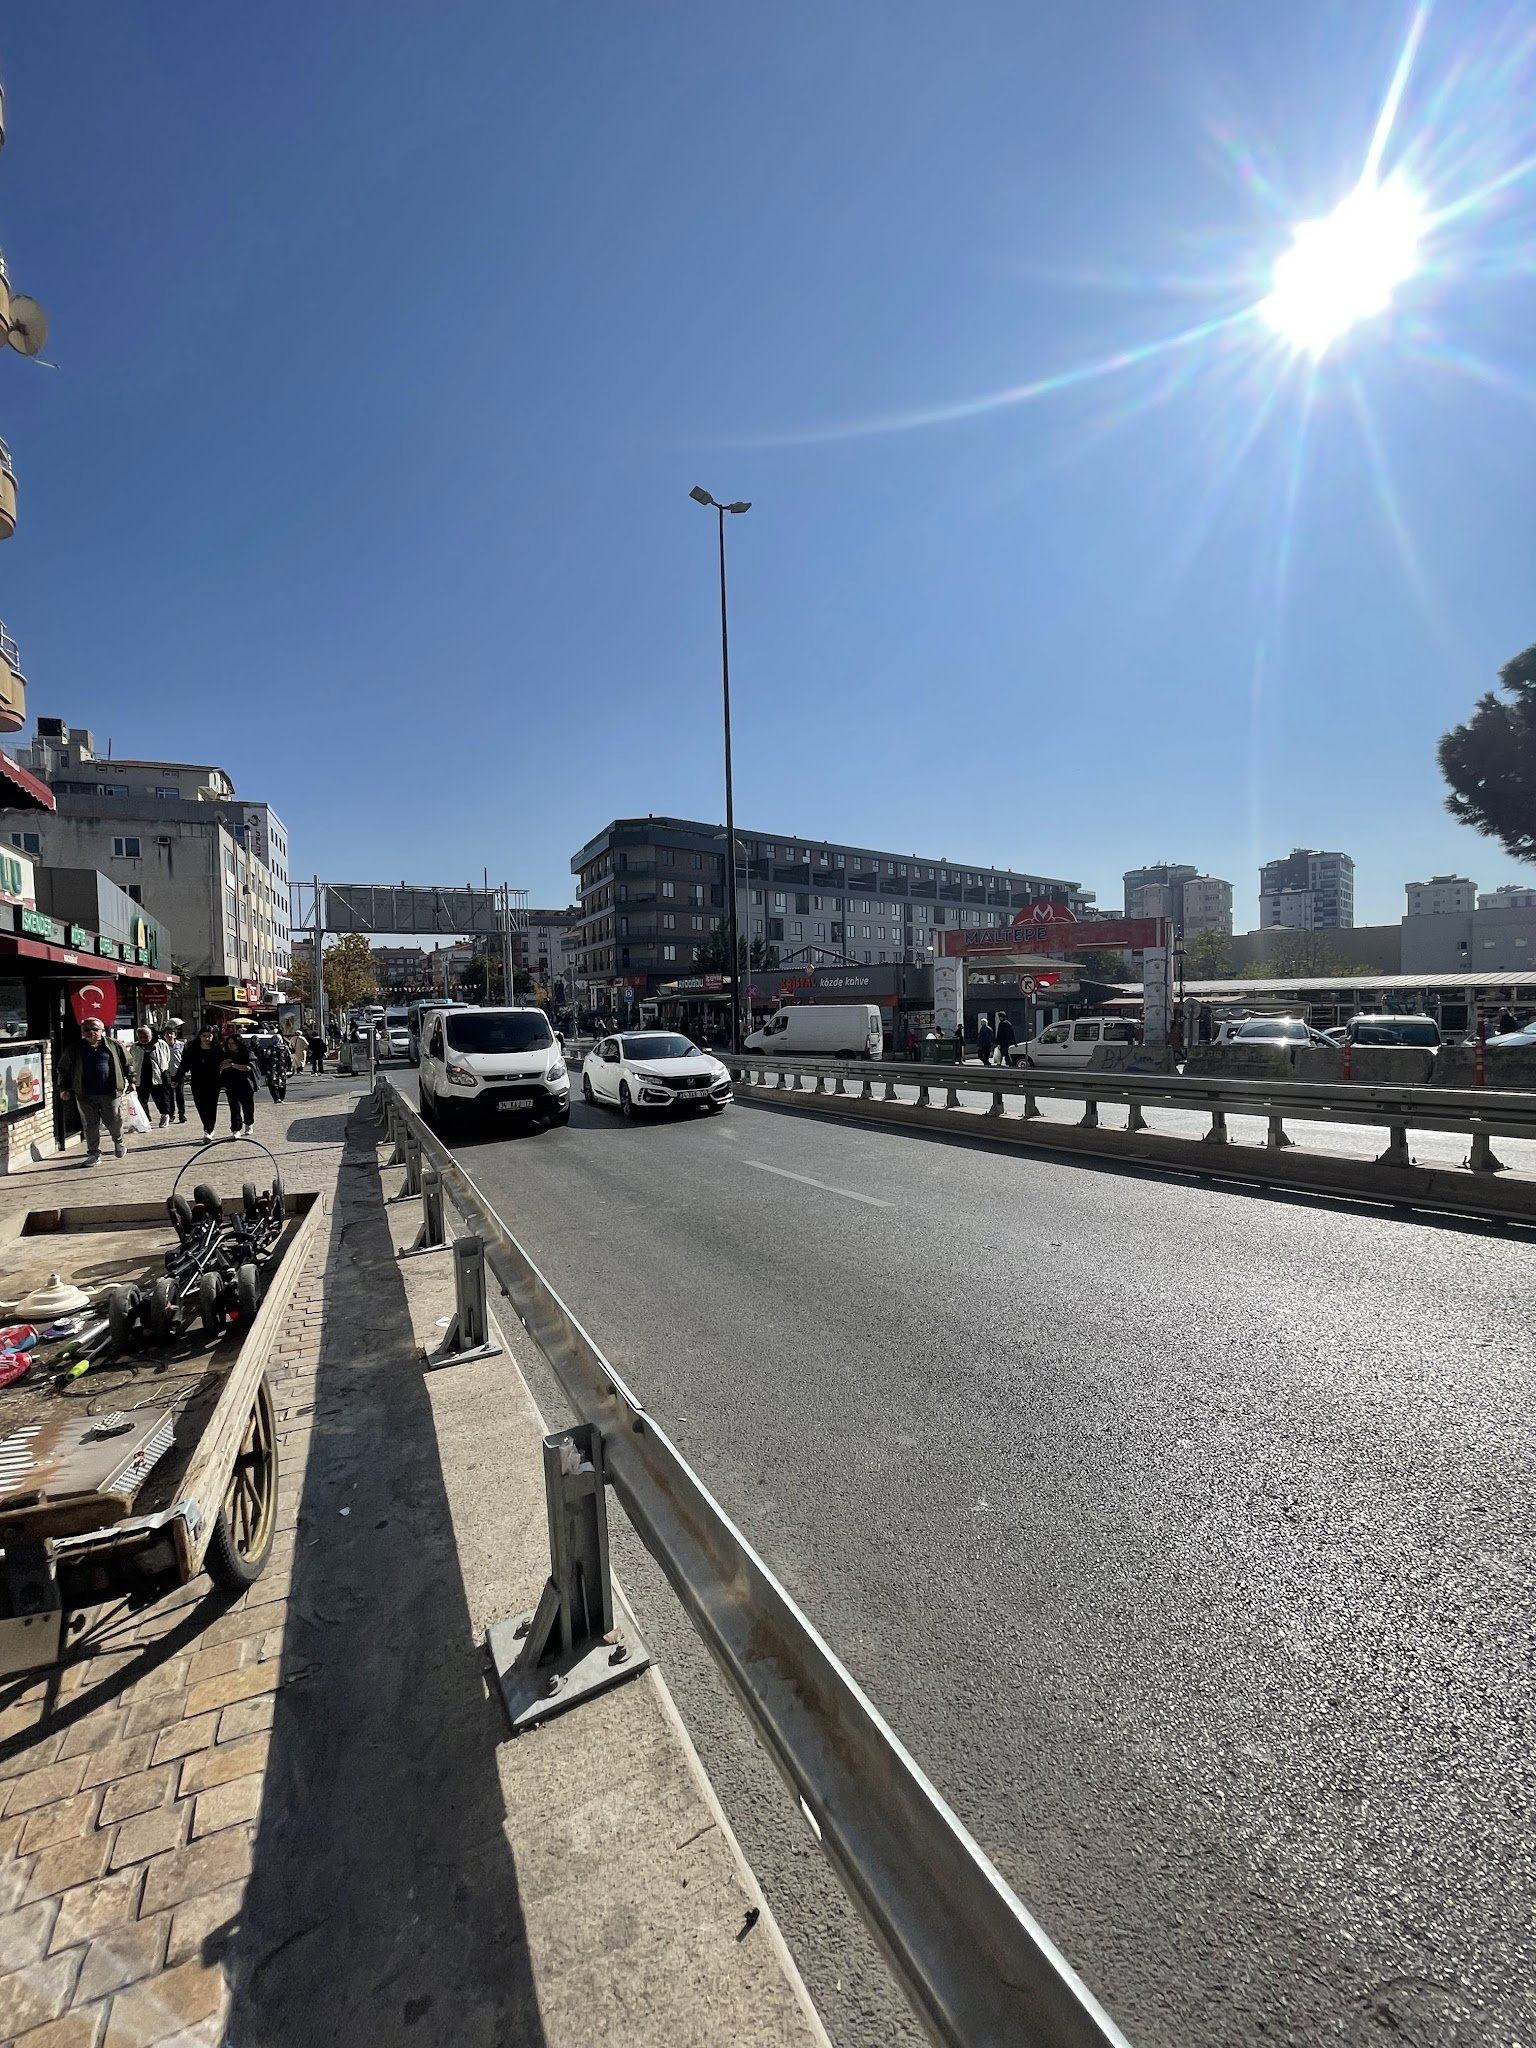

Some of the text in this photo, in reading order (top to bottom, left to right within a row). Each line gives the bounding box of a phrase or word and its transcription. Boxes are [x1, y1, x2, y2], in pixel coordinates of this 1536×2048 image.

[965, 927, 1046, 944] MALTEPE
[820, 978, 843, 987] közde
[845, 976, 869, 986] kahve
